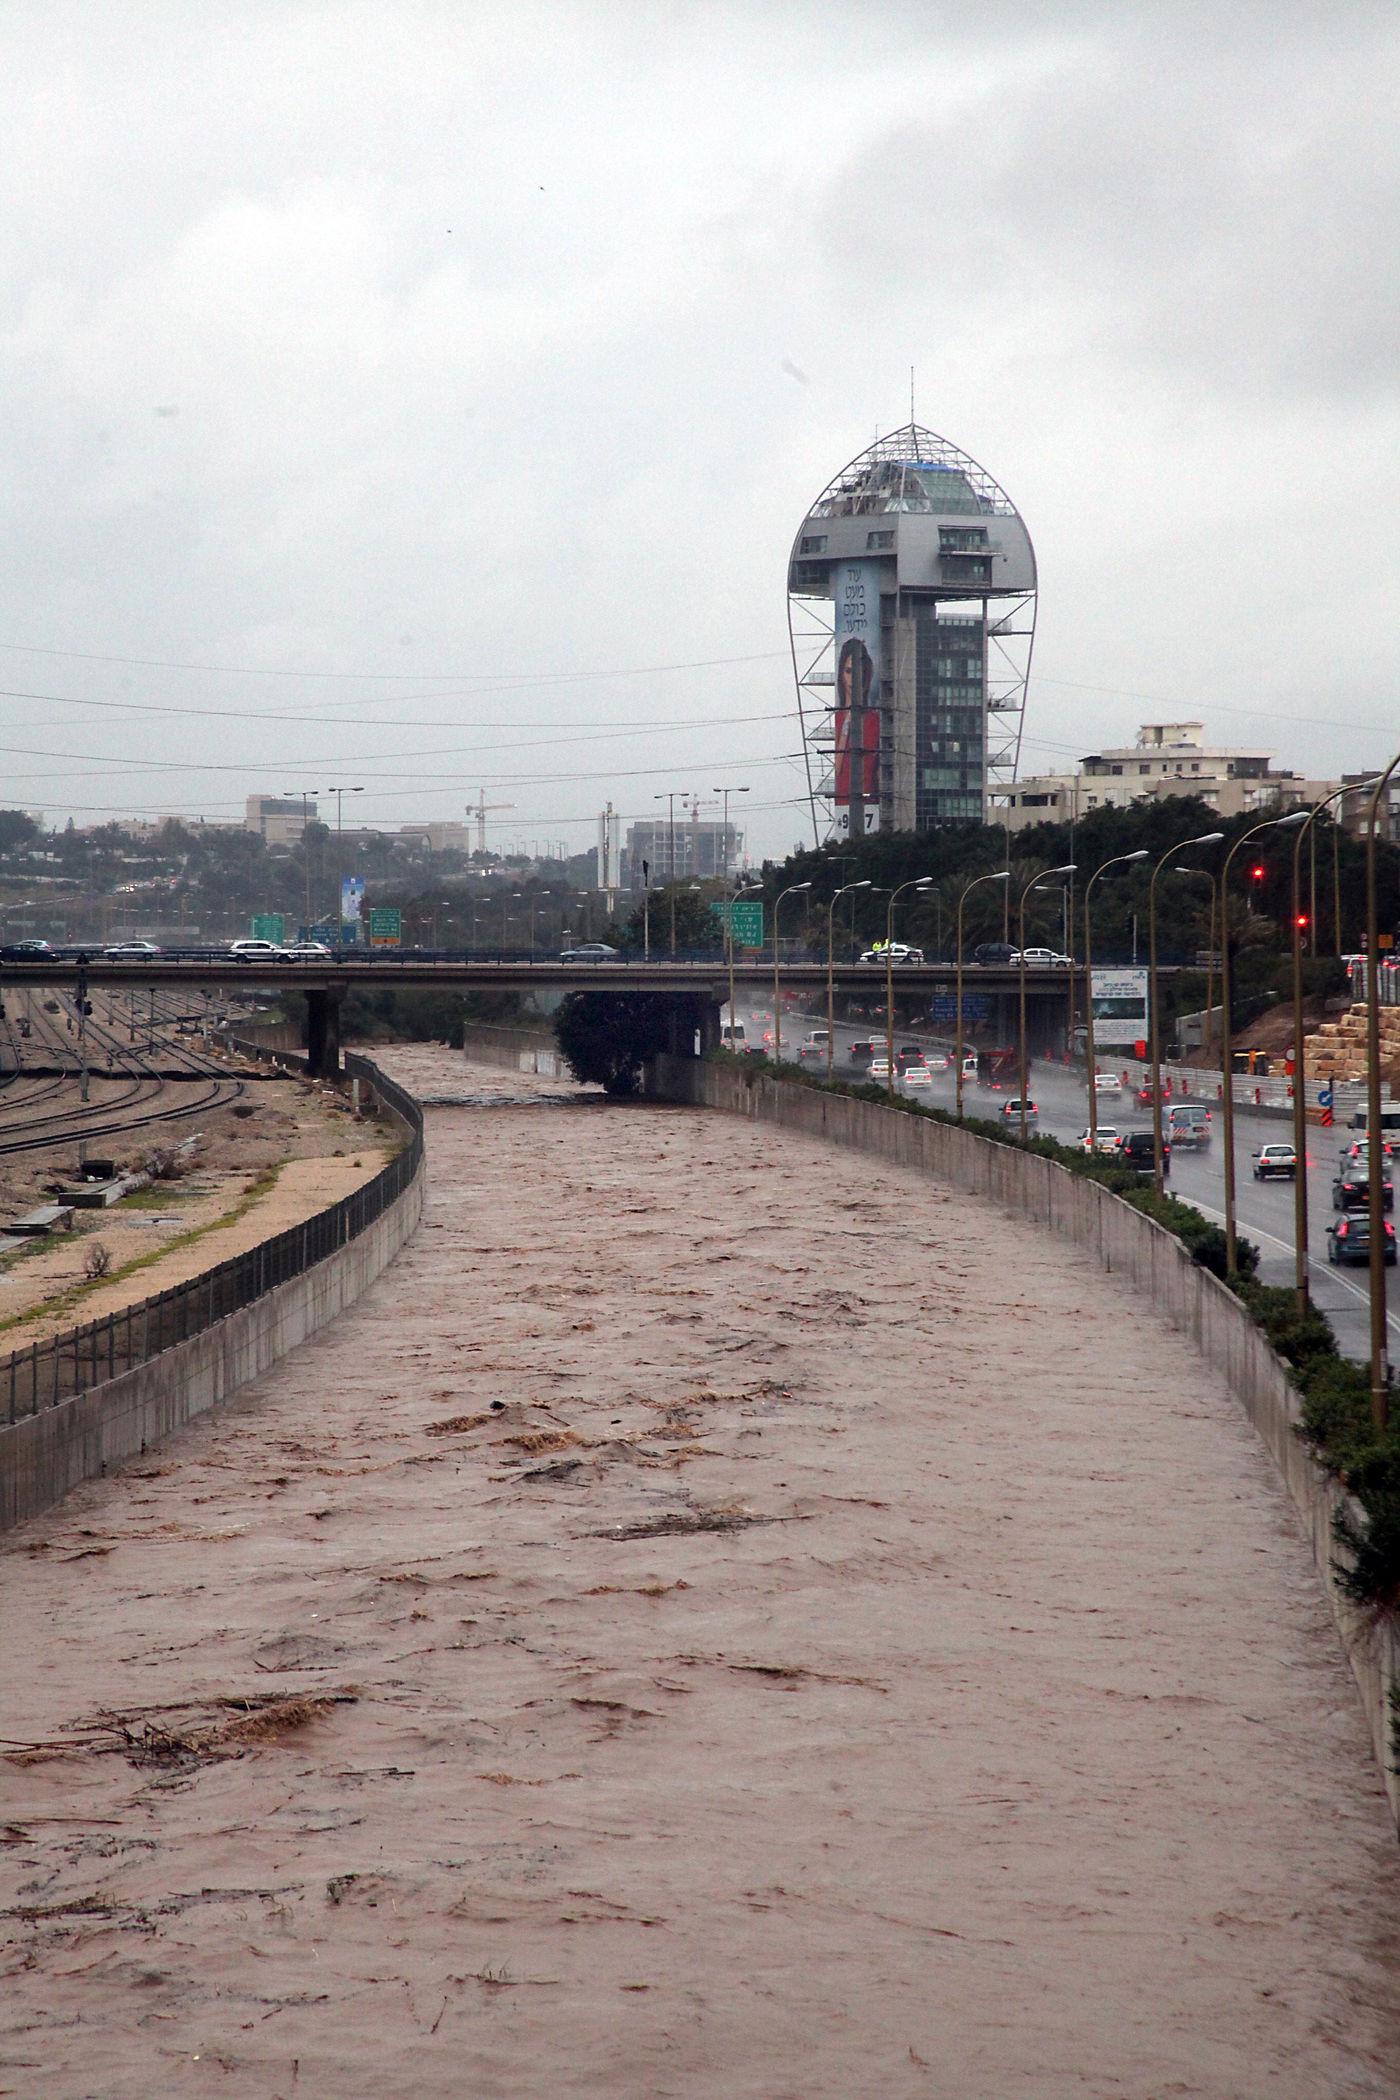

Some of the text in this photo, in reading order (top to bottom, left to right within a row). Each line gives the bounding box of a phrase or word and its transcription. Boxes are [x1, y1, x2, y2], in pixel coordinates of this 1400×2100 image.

[847, 568, 862, 583] עוד
[845, 584, 864, 600] מעט
[843, 602, 866, 616] כולם
